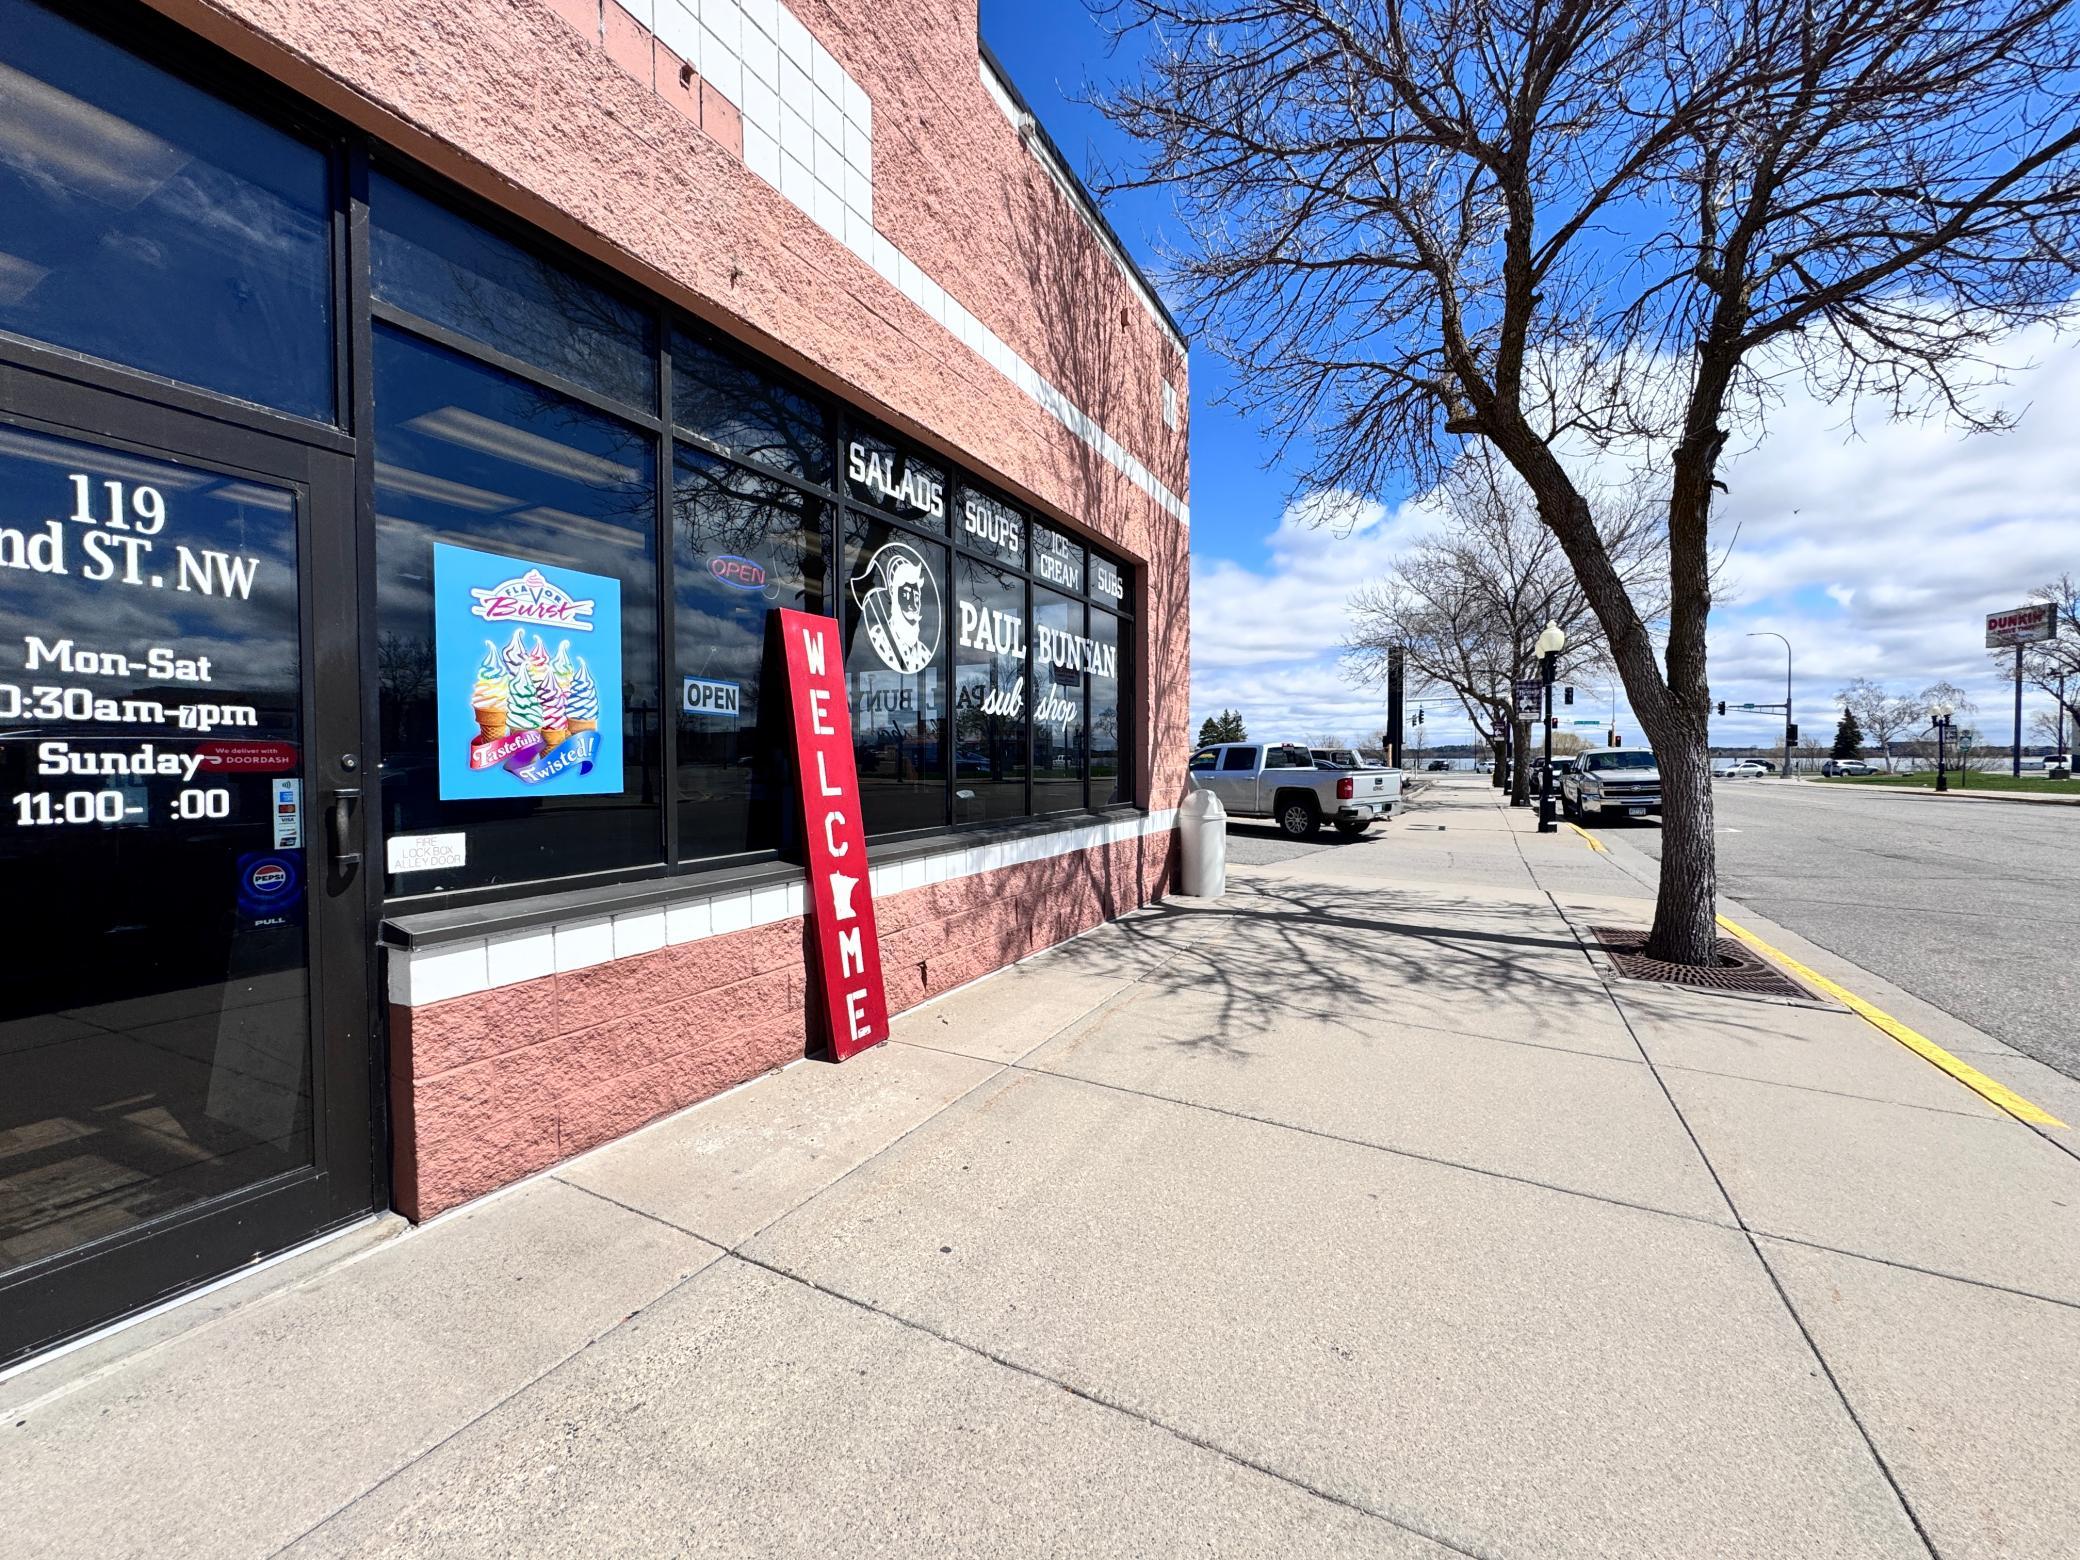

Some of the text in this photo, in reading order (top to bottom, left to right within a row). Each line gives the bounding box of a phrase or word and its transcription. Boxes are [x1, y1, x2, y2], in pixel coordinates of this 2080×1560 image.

[849, 441, 944, 518] SALADS
[68, 474, 166, 535] 119
[965, 500, 1019, 553] SOUPS
[0, 520, 260, 600] nd ST. NW
[1051, 531, 1069, 560] ICE
[711, 558, 766, 585] OPEN
[1040, 553, 1079, 591] CREAM
[1097, 567, 1124, 600] SUBS
[484, 596, 587, 620] Burst
[504, 585, 562, 605] FLAVOR
[959, 600, 1116, 679] PAUL BUNYAN
[24, 636, 212, 682] Mon-Sat
[687, 683, 737, 711] OPEN
[980, 676, 1078, 733] sub shop
[38, 742, 205, 782] Sunday
[226, 756, 289, 764] DOORDASH
[472, 732, 541, 768] Tastefully
[519, 737, 595, 782] Twisted!
[415, 837, 437, 847] FIRE
[802, 628, 872, 1041] WELCME
[395, 855, 461, 869] ALLEY DOOR
[402, 846, 454, 859] LOCK BOX
[255, 873, 285, 882] PEPSI
[254, 918, 286, 927] PULL
